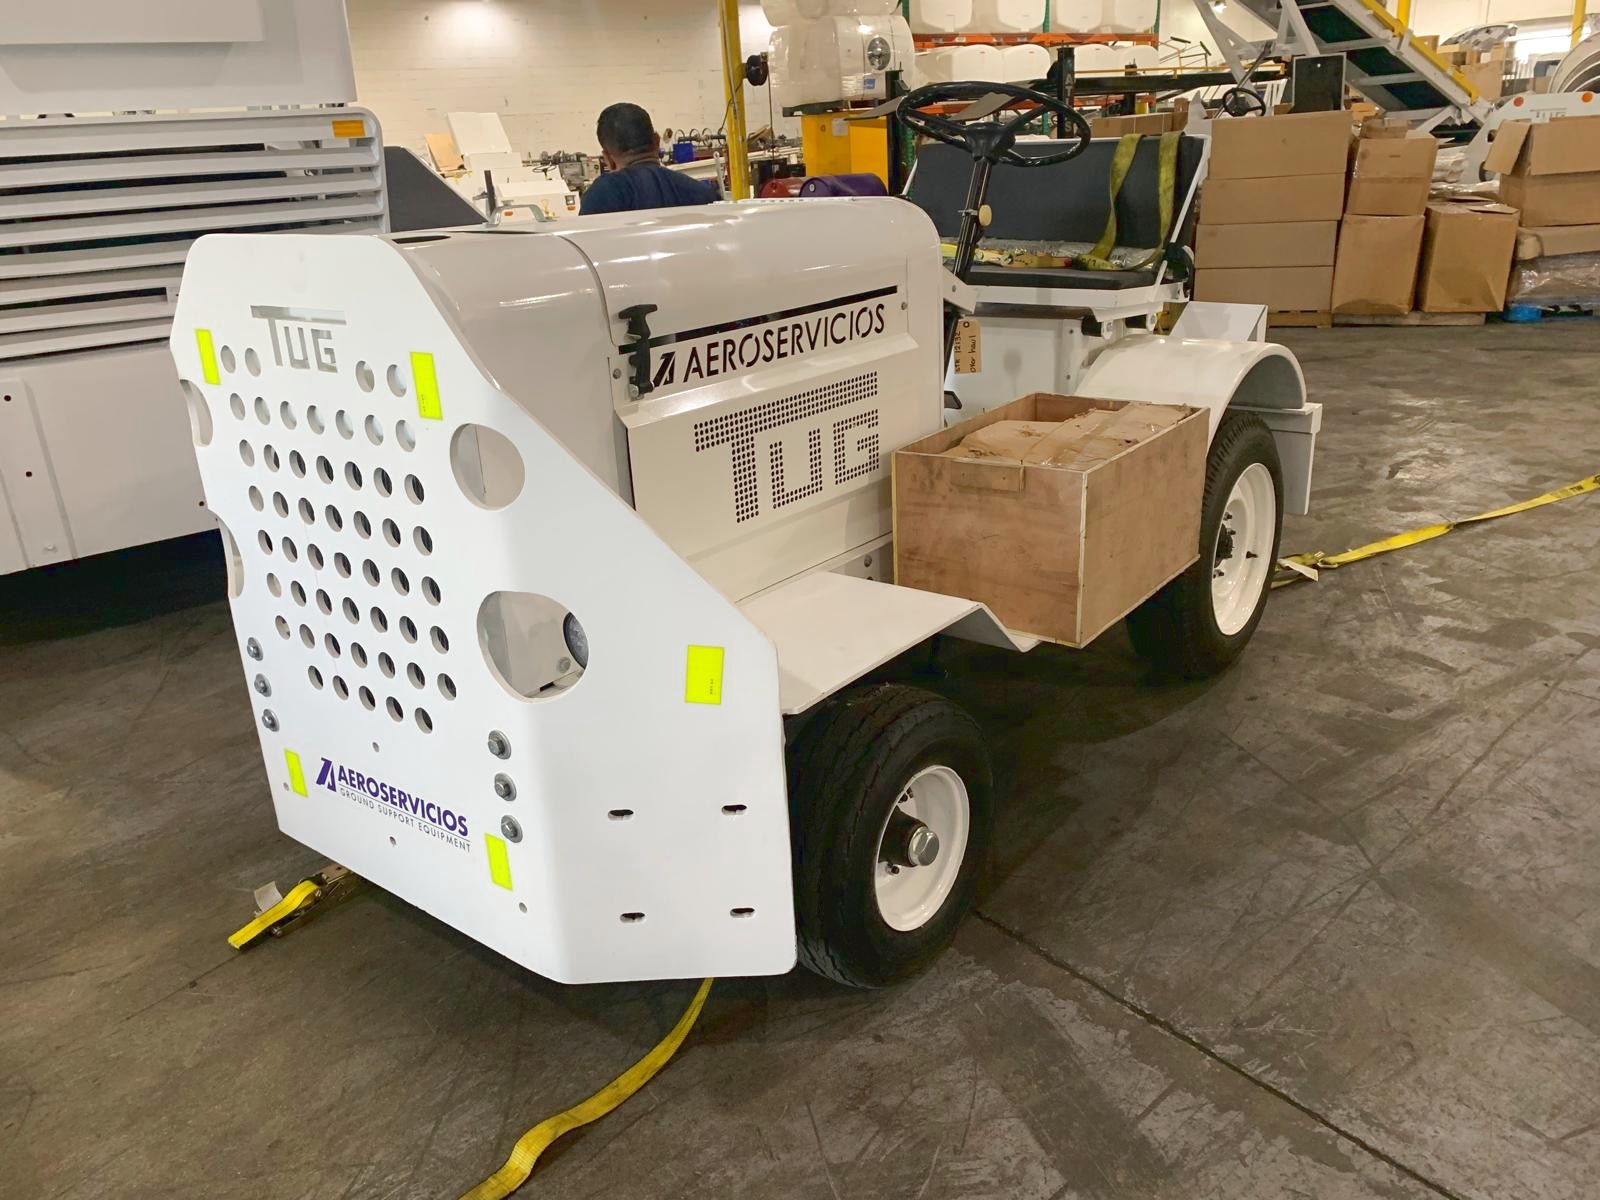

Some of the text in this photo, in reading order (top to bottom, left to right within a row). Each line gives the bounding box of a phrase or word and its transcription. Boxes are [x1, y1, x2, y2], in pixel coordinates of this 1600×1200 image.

[1064, 74, 1073, 132] ATS
[250, 305, 347, 374] TUG
[683, 303, 885, 383] AEROSERVICIOS
[693, 370, 880, 524] TUG
[337, 764, 469, 838] AEROSERVICIOS
[340, 787, 471, 853] GROUND SUPPORT EQUIPMENT
